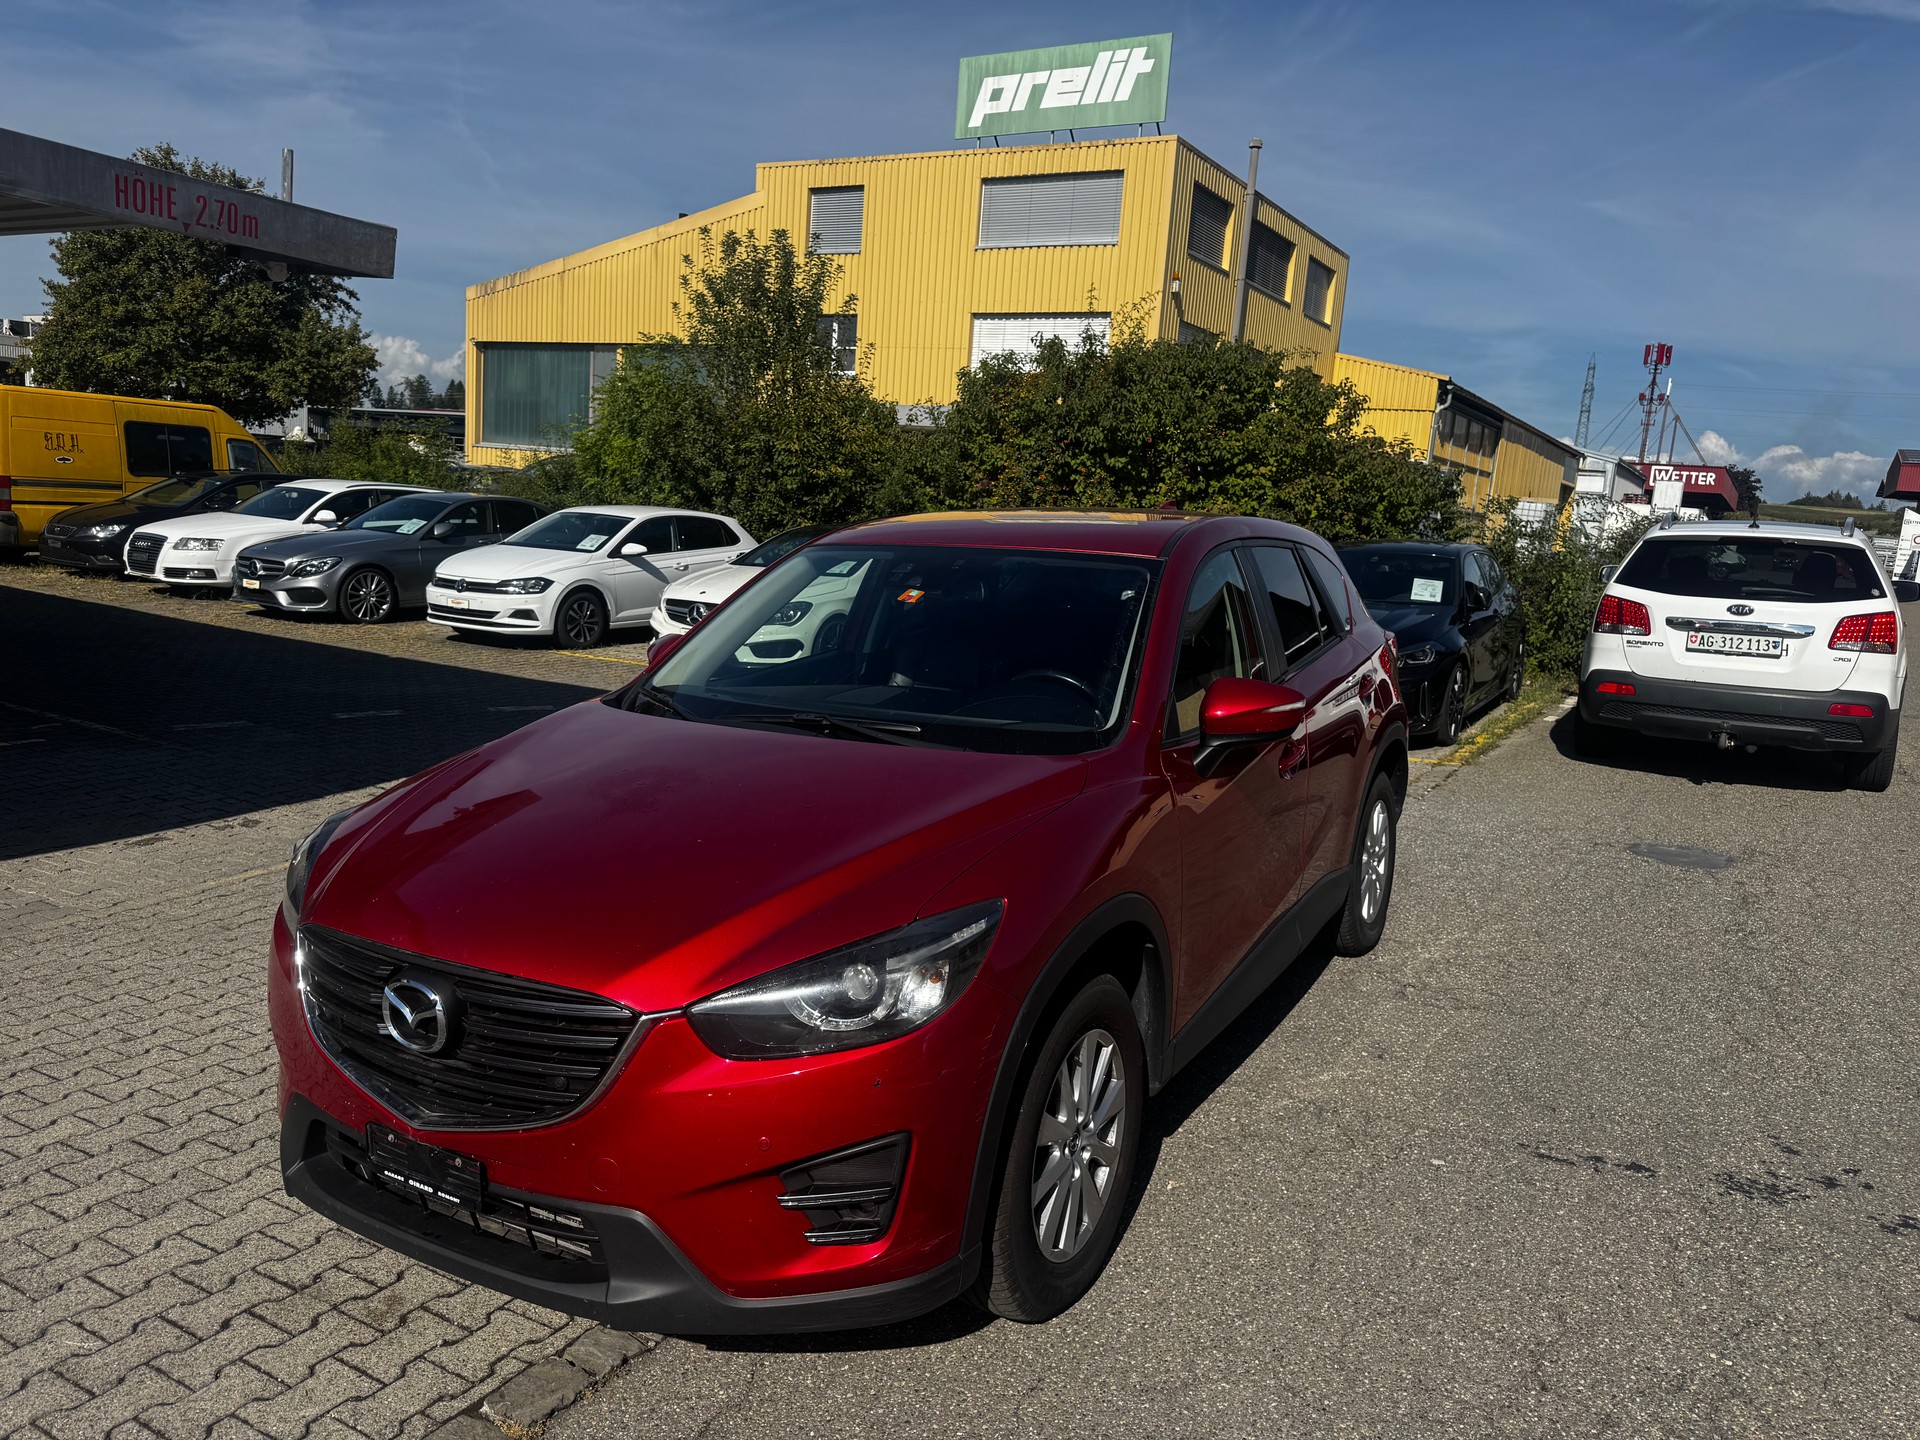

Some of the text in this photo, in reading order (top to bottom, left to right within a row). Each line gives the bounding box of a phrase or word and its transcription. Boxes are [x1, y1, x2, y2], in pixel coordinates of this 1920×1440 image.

[967, 46, 1156, 128] prelit
[114, 171, 177, 221] HÖHE
[1651, 466, 1716, 486] WETTER
[1731, 605, 1751, 615] KIA
[1626, 639, 1664, 647] SORENTO
[383, 1170, 461, 1204] GARAGE GIRARD ROMONT
